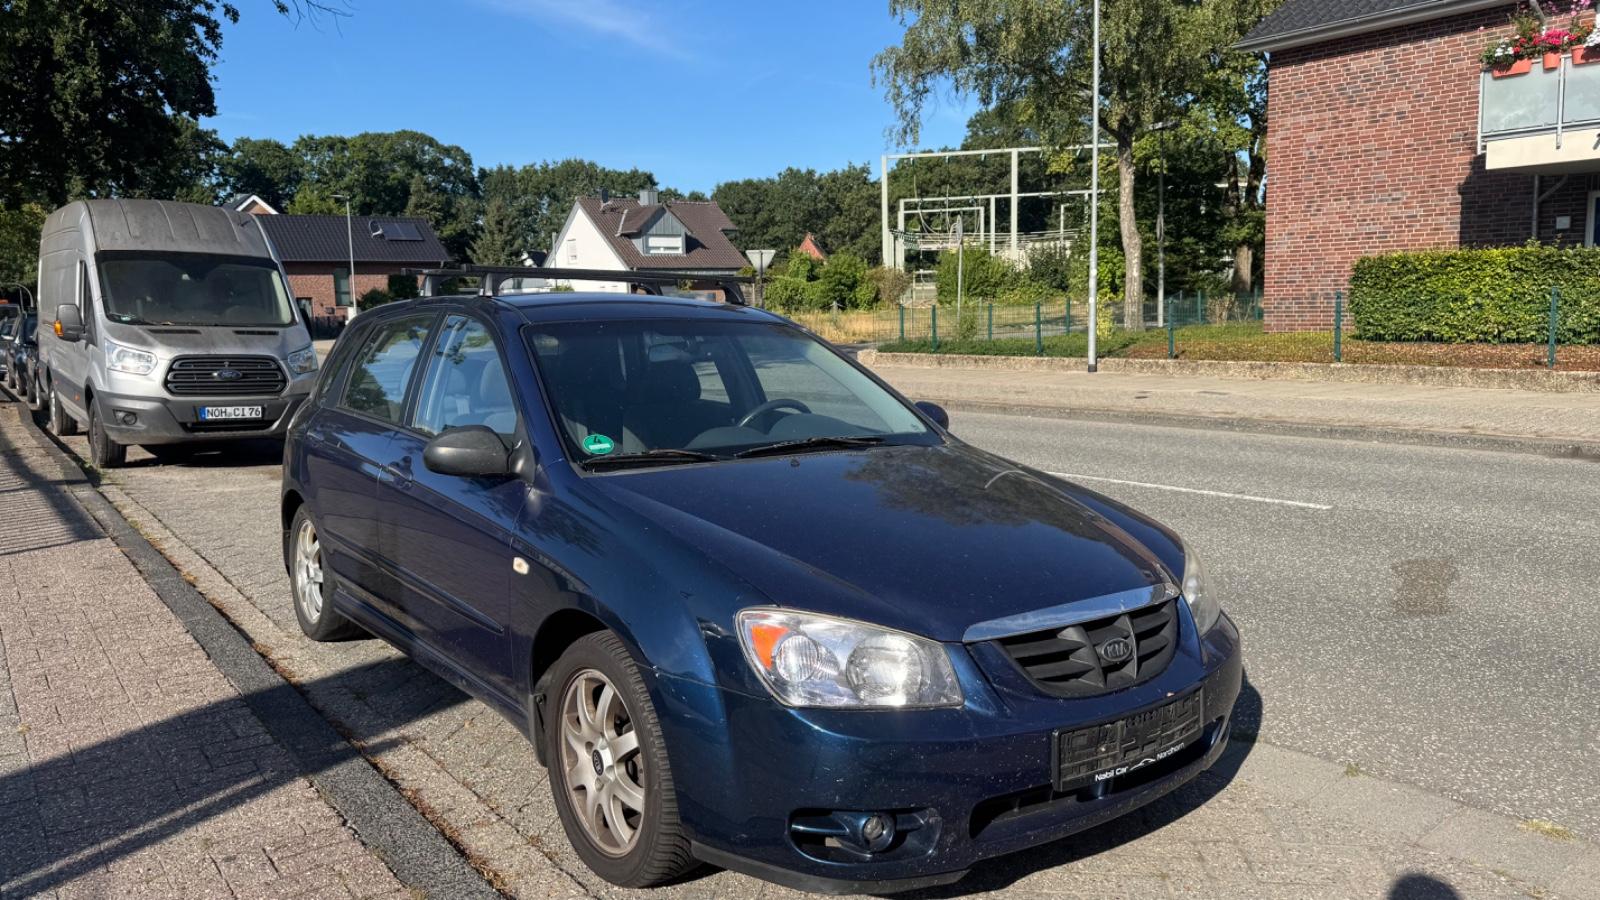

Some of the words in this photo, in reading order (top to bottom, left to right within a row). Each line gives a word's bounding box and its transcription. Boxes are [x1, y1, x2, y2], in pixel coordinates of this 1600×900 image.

[207, 407, 227, 418] NOH
[233, 407, 246, 417] CI
[249, 407, 261, 417] 76
[1115, 766, 1129, 777] Car
